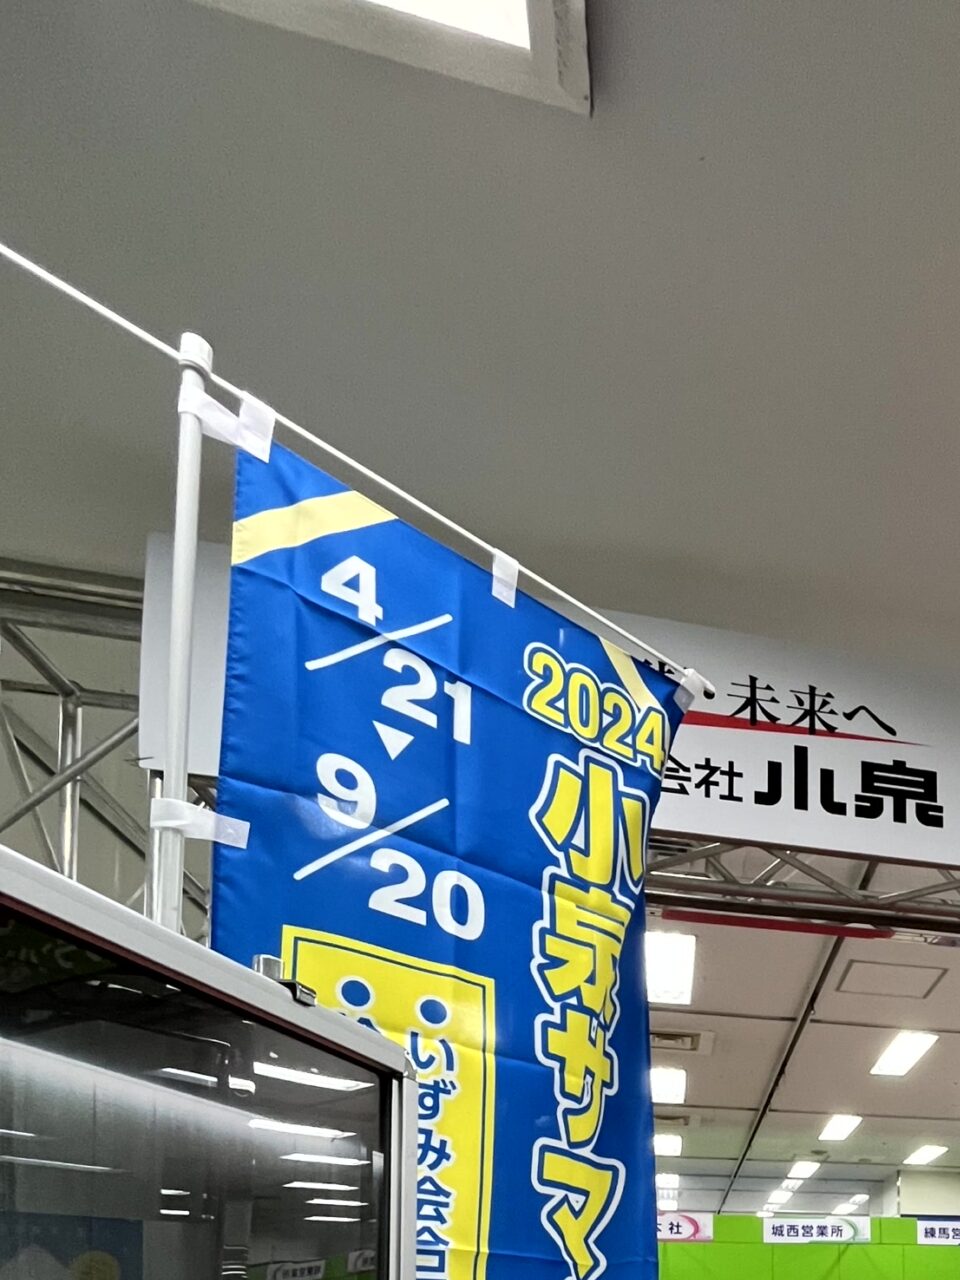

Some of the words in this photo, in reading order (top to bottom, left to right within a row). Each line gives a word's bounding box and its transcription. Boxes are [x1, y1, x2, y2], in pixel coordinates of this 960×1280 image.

[523, 641, 667, 771] 2024
[754, 744, 945, 829] 小泉
[771, 1224, 844, 1238] 城西営業所
